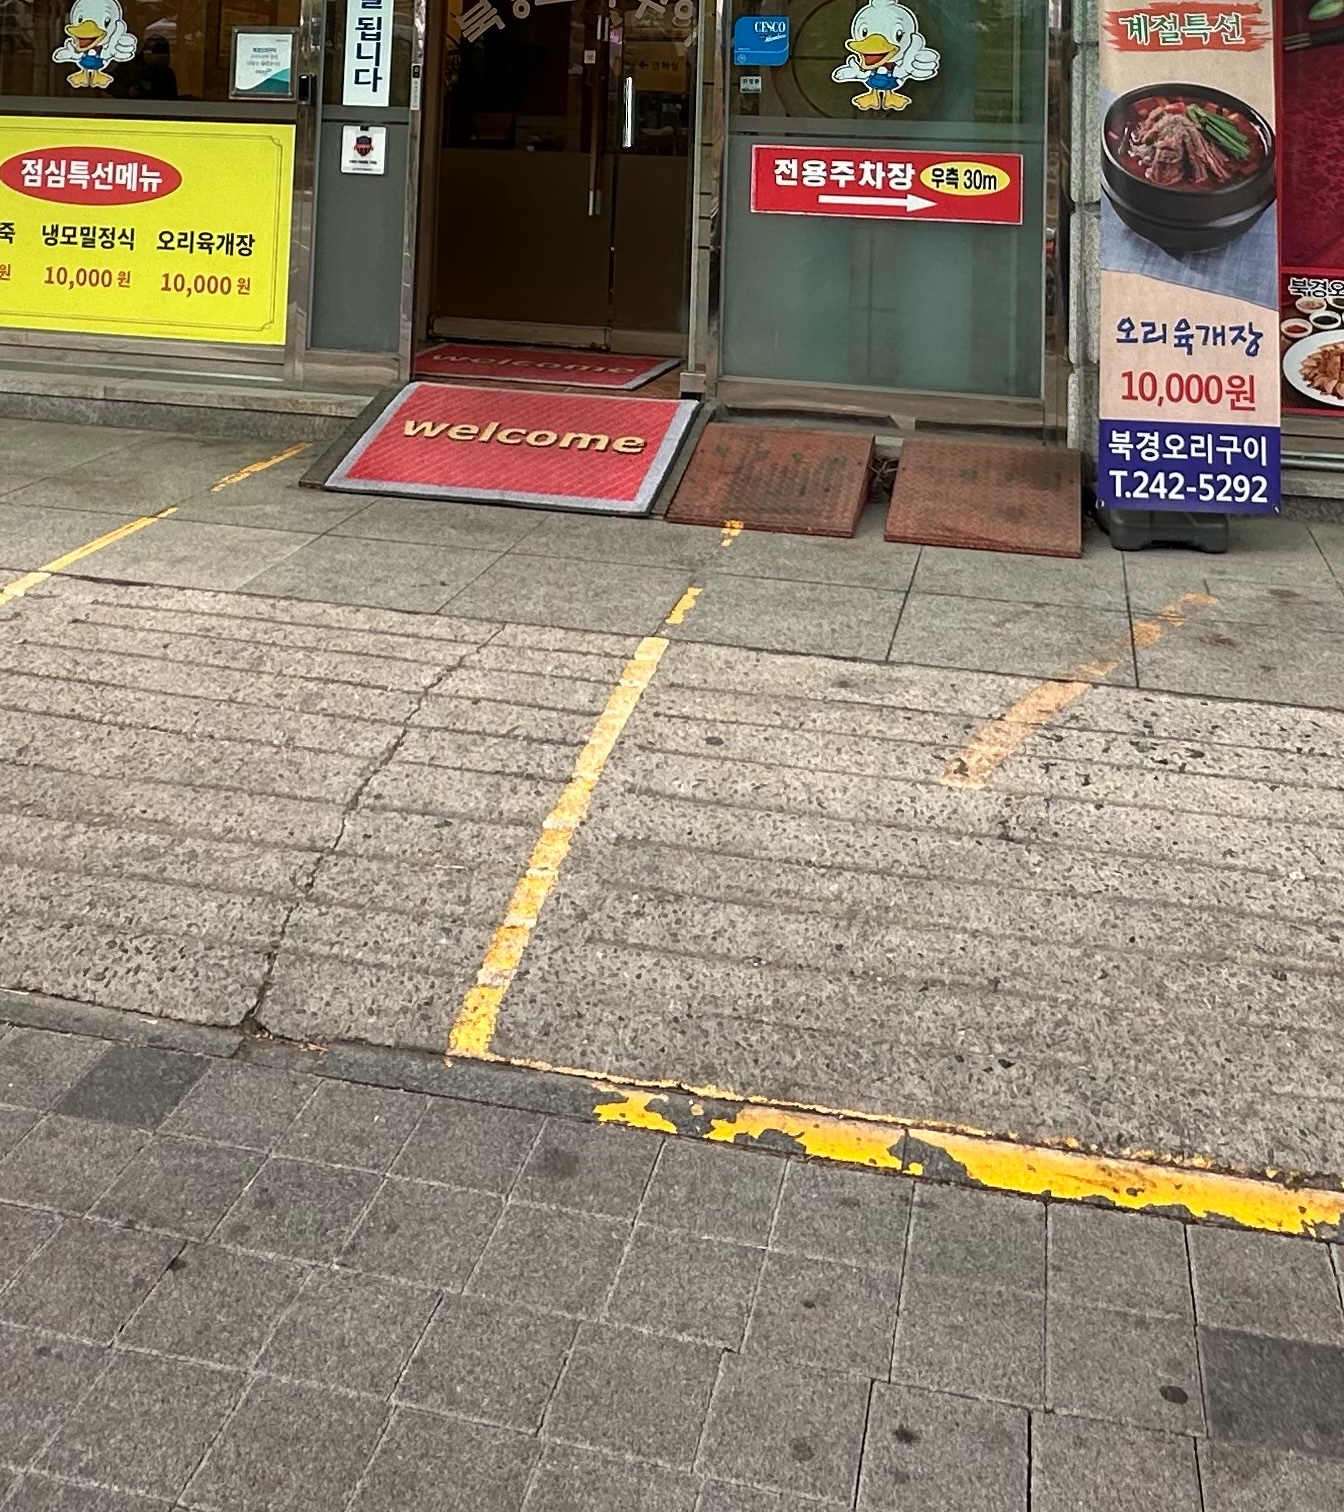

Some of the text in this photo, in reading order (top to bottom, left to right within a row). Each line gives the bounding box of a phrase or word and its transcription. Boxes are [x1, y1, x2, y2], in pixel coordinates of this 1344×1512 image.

[1119, 10, 1247, 46] 계절특선
[354, 16, 383, 93] 됩니다
[20, 158, 163, 194] 점심특선메뉴
[774, 158, 998, 191] 전용주차장 우측 30m
[41, 224, 136, 251] 냉모밀정식
[156, 229, 256, 257] 오리육개장
[1115, 316, 1264, 358] 오리육개장
[1120, 370, 1256, 412] 10,000원
[402, 417, 648, 456] welcome
[1107, 429, 1268, 467] 북경오리구이
[1108, 469, 1269, 504] T.242-5292
